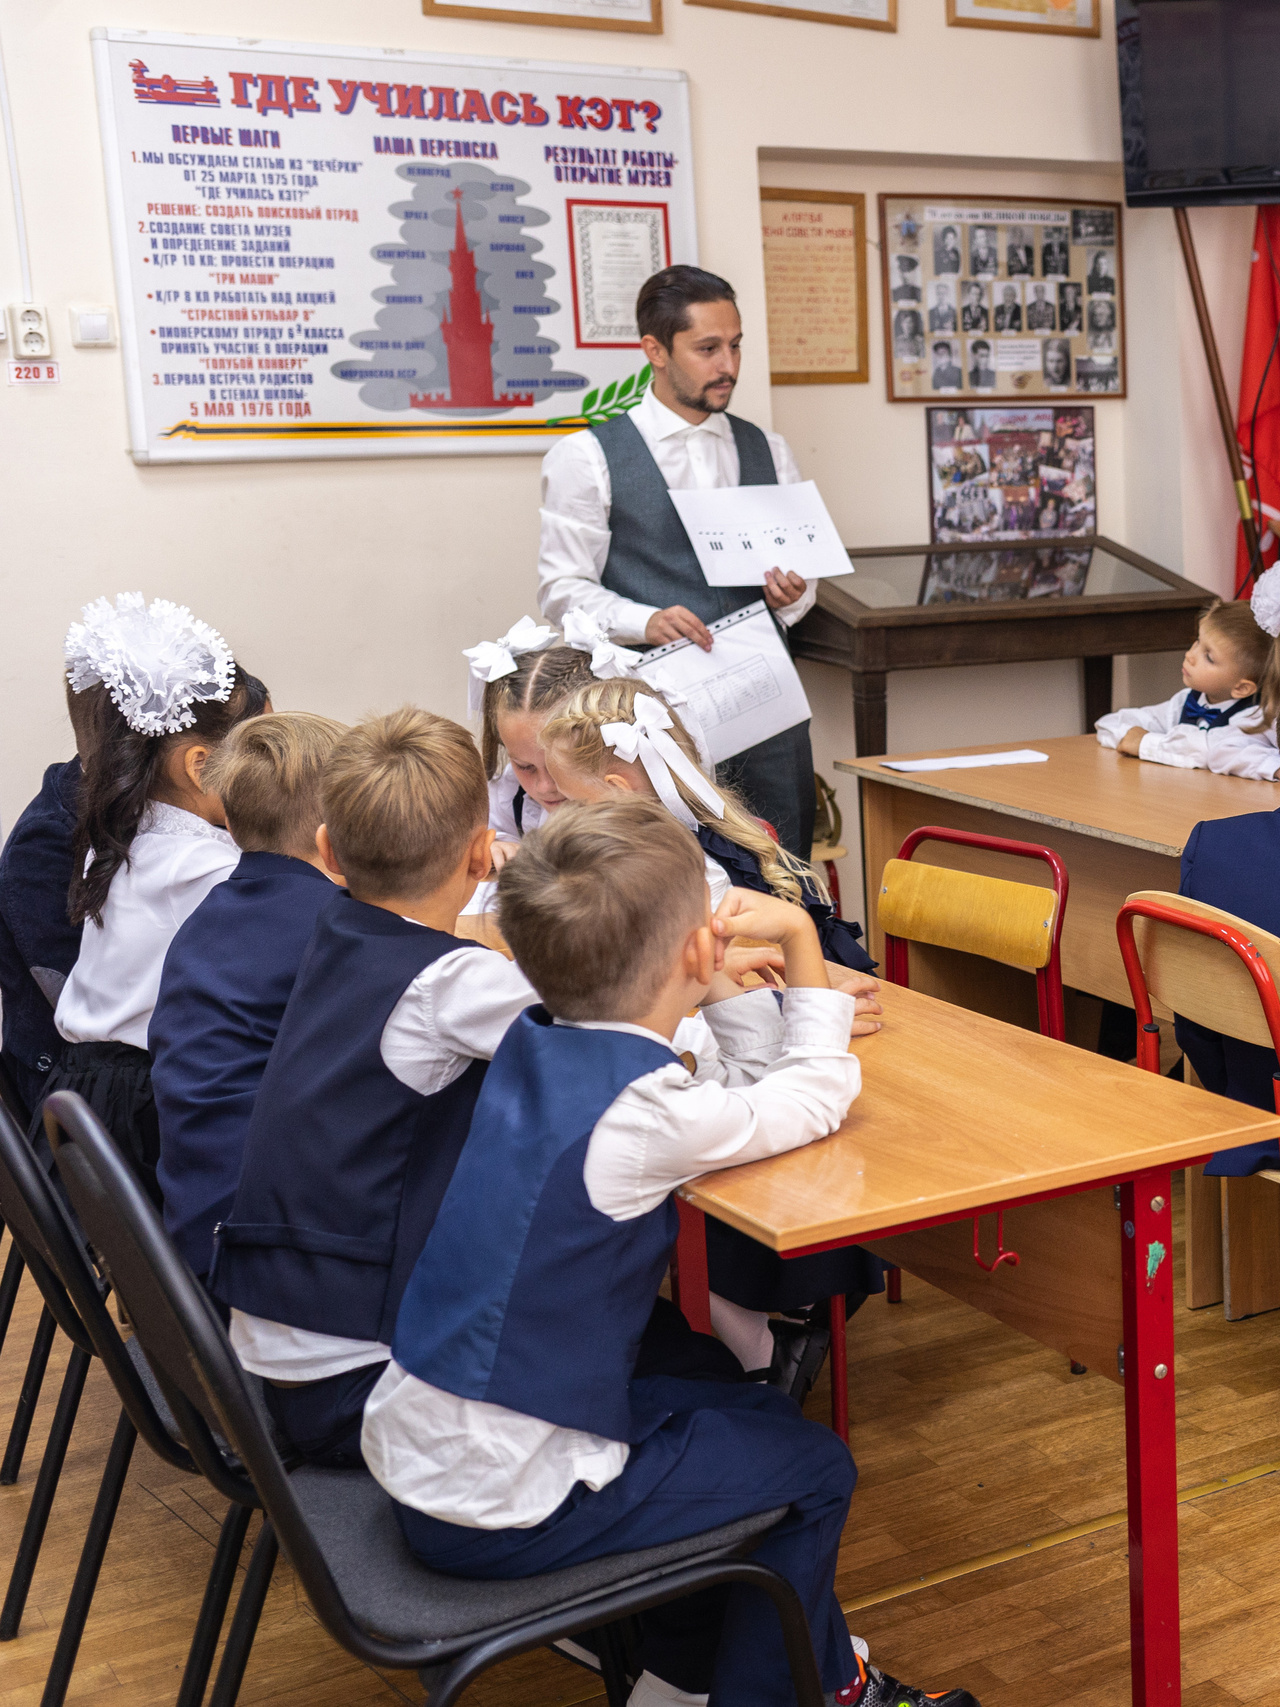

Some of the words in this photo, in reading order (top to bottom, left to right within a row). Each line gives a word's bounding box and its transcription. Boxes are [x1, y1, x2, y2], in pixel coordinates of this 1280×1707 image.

[229, 72, 322, 118] ГДЕ
[327, 79, 549, 127] УЧИЛАСЬ
[556, 95, 662, 134] КЭТ?
[171, 124, 234, 147] ПЕРВЫЕ
[239, 128, 281, 149] ШАГИ
[373, 136, 415, 157] НАША
[419, 139, 499, 160] ПЕРЕПИСКА
[544, 145, 616, 165] РЕЗУЛЬТАТ
[168, 153, 239, 168] ОБСУЖДАЕМ
[243, 155, 285, 170] СТАТЬЮ
[289, 157, 302, 170] ИЗ
[184, 170, 197, 182] ОТ
[201, 170, 215, 183] 25
[219, 171, 257, 185] МАРТА
[261, 173, 288, 186] 1975
[292, 174, 318, 187] ГОДА
[554, 165, 621, 185] ОТКРЫТИЕ
[627, 169, 672, 188] МУЗЕЯ
[227, 186, 274, 200] УЧИЛАСЬ
[147, 203, 201, 217] РЕШЕНИЕ:
[205, 205, 253, 219] СОЗДАТЬ
[257, 206, 322, 221] ПОИСКОВЫЙ
[326, 208, 359, 223] ОТРЯД
[211, 223, 250, 236] СОВЕТА
[254, 224, 291, 238] МУЗЕЯ
[151, 238, 158, 249] И
[162, 238, 236, 252] ОПРЕДЕЛЕНИЕ
[241, 239, 290, 253] ЗАДАНИЙ
[153, 254, 177, 269] К/ГР
[183, 255, 195, 267] 10
[221, 255, 275, 268] ПРОВЕСТИ
[279, 257, 335, 270] ОПЕРАЦИЮ
[156, 290, 180, 305] К/ГР
[213, 291, 267, 304] РАБОТАТЬ
[271, 292, 292, 305] НАД
[296, 291, 336, 305] АКЦИЕЙ
[252, 309, 299, 322] БУЛЬВАР
[158, 327, 238, 339] ПИОНЕРСКОМУ
[243, 327, 283, 340] ОТРЯДУ
[304, 327, 344, 339] КЛАССА
[161, 342, 210, 354] ПРИНЯТЬ
[213, 342, 261, 354] УЧАСТИЕ
[265, 343, 271, 354] В
[275, 343, 328, 356] ОПЕРАЦИИ
[15, 366, 41, 379] 220
[209, 373, 255, 386] ВСТРЕЧА
[259, 373, 313, 386] РАДИСТОВ
[209, 389, 216, 400] В
[220, 389, 259, 401] СТЕНАХ
[190, 403, 198, 416] 5
[204, 403, 234, 417] МАЯ
[241, 403, 273, 417] 1976
[278, 403, 311, 418] ГОДА
